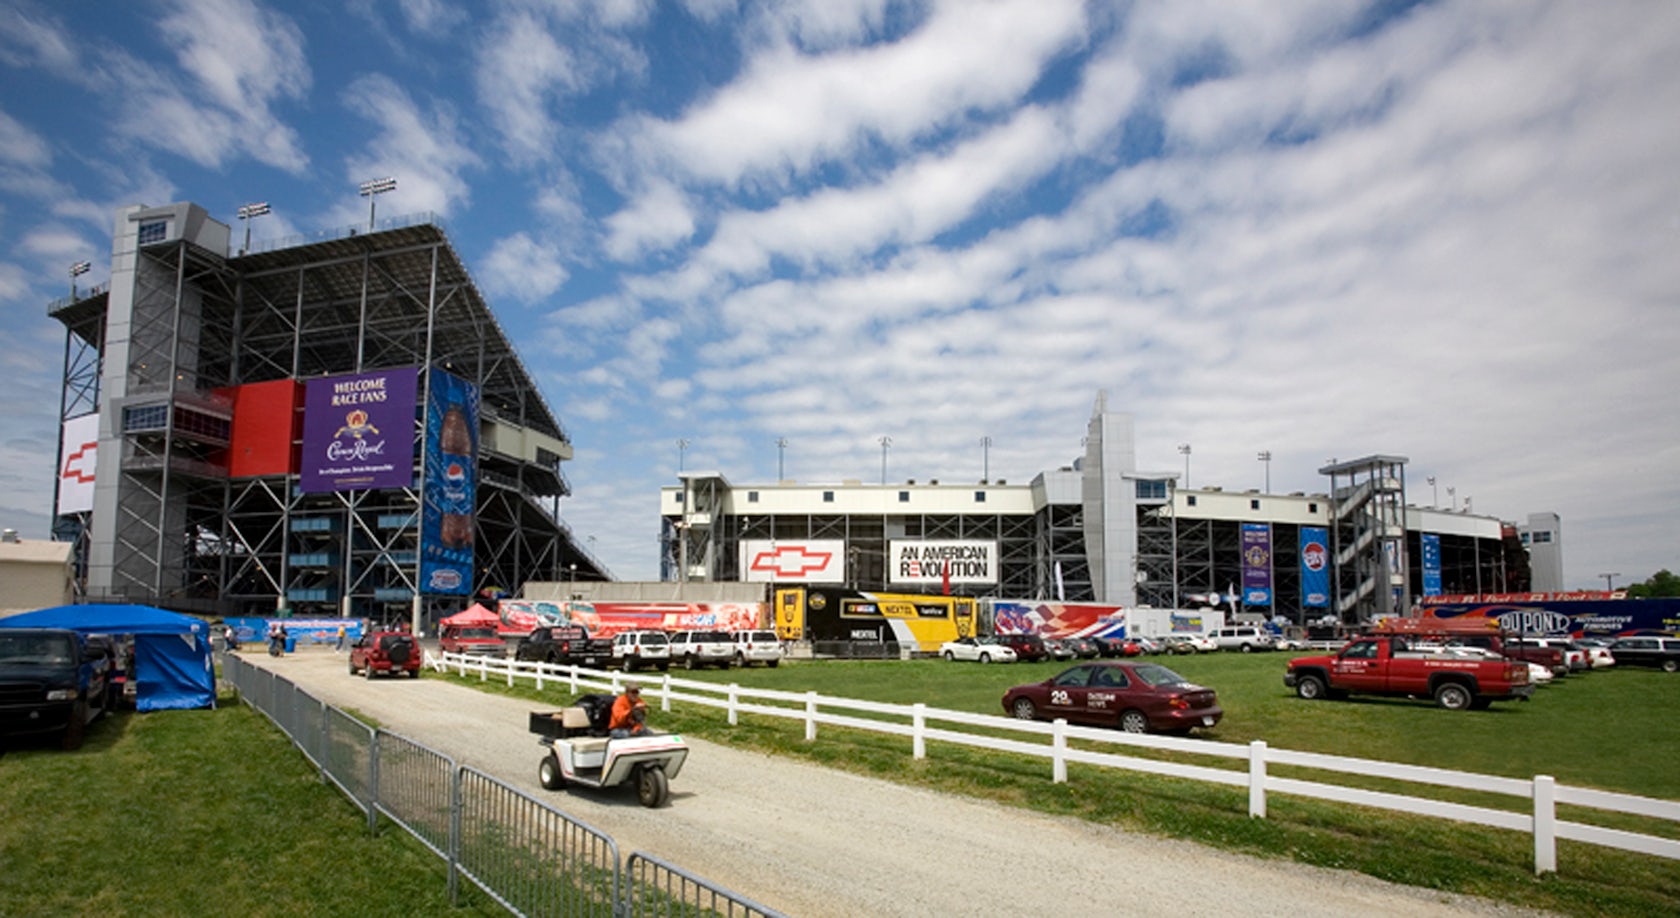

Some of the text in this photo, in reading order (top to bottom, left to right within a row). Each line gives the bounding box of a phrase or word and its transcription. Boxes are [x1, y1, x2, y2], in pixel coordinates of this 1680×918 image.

[334, 378, 386, 394] WELCOME
[331, 391, 387, 407] RACE FANS
[327, 440, 385, 461] Crown Royal
[900, 546, 988, 561] AN AMERICAN
[900, 561, 988, 577] REVOLUTION
[886, 605, 913, 615] NEXTEL
[1575, 615, 1633, 624] AUTOMOTIVE
[851, 630, 878, 640] NEXTEL
